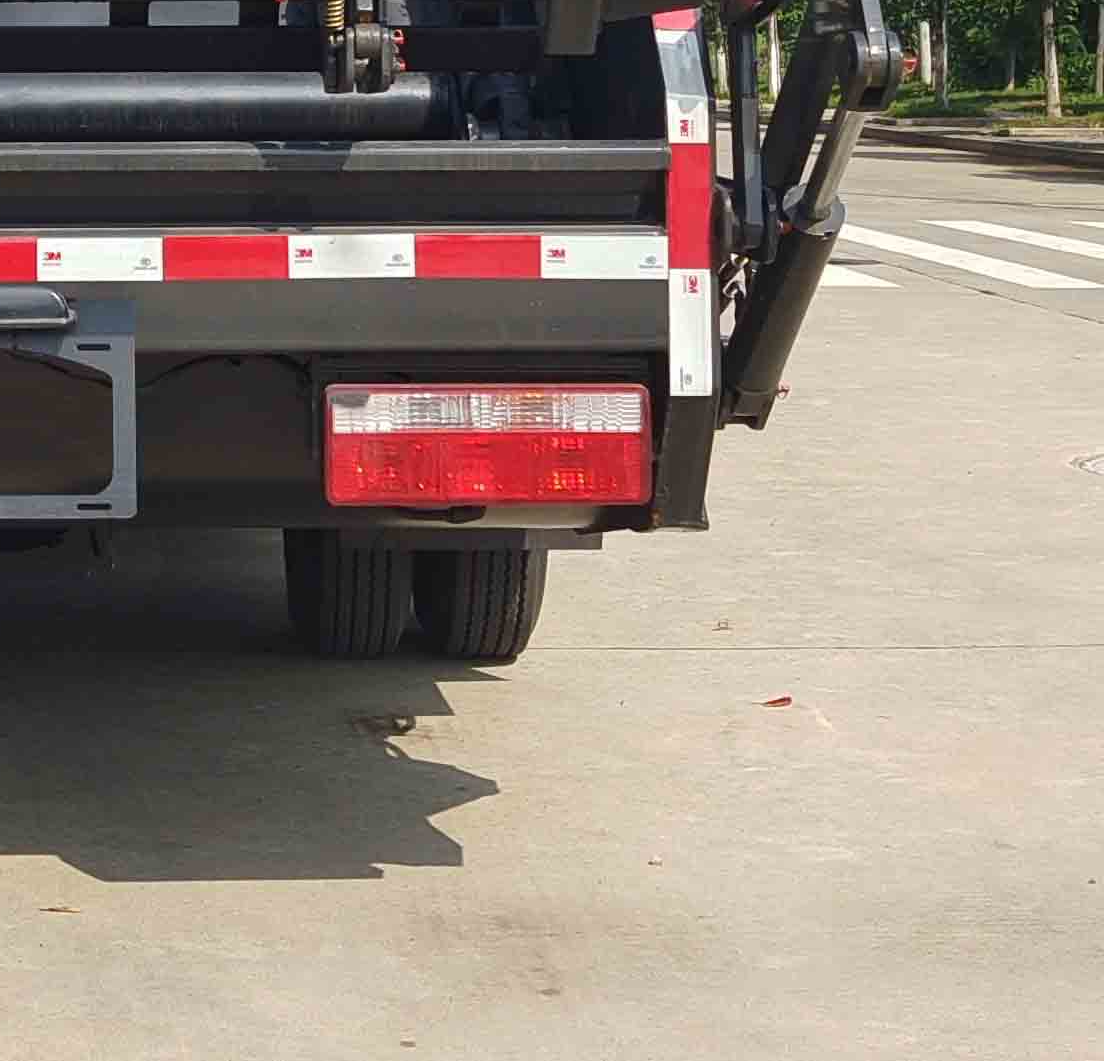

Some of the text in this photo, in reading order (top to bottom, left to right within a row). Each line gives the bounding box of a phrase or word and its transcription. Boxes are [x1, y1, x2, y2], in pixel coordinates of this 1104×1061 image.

[679, 119, 689, 137] 3M
[43, 251, 62, 261] 3M
[295, 248, 313, 258] 3M
[547, 248, 566, 258] 3M
[687, 275, 698, 293] 3M
